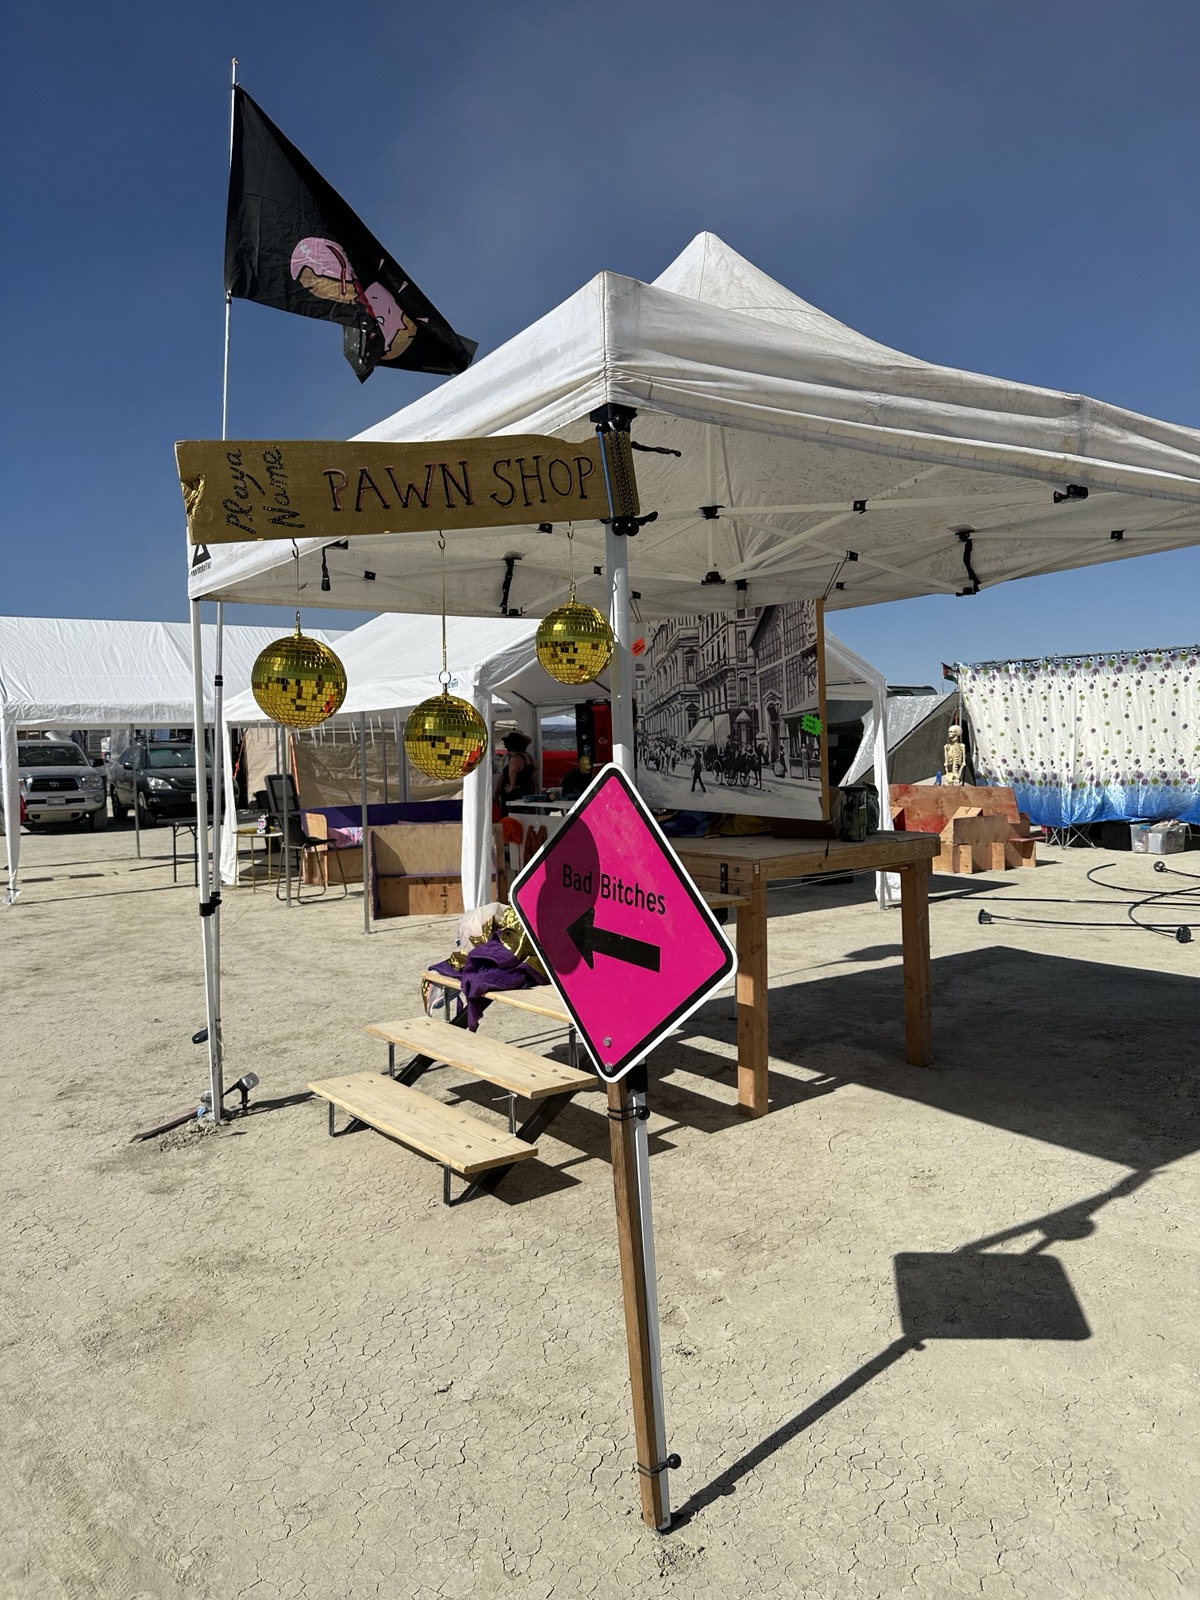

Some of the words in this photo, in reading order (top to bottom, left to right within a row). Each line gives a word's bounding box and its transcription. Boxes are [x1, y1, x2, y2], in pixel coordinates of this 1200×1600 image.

[262, 446, 306, 528] Name
[322, 460, 475, 512] PAWN
[490, 454, 595, 508] SHOP
[562, 863, 592, 895] Bad
[600, 873, 666, 916] Bitches
